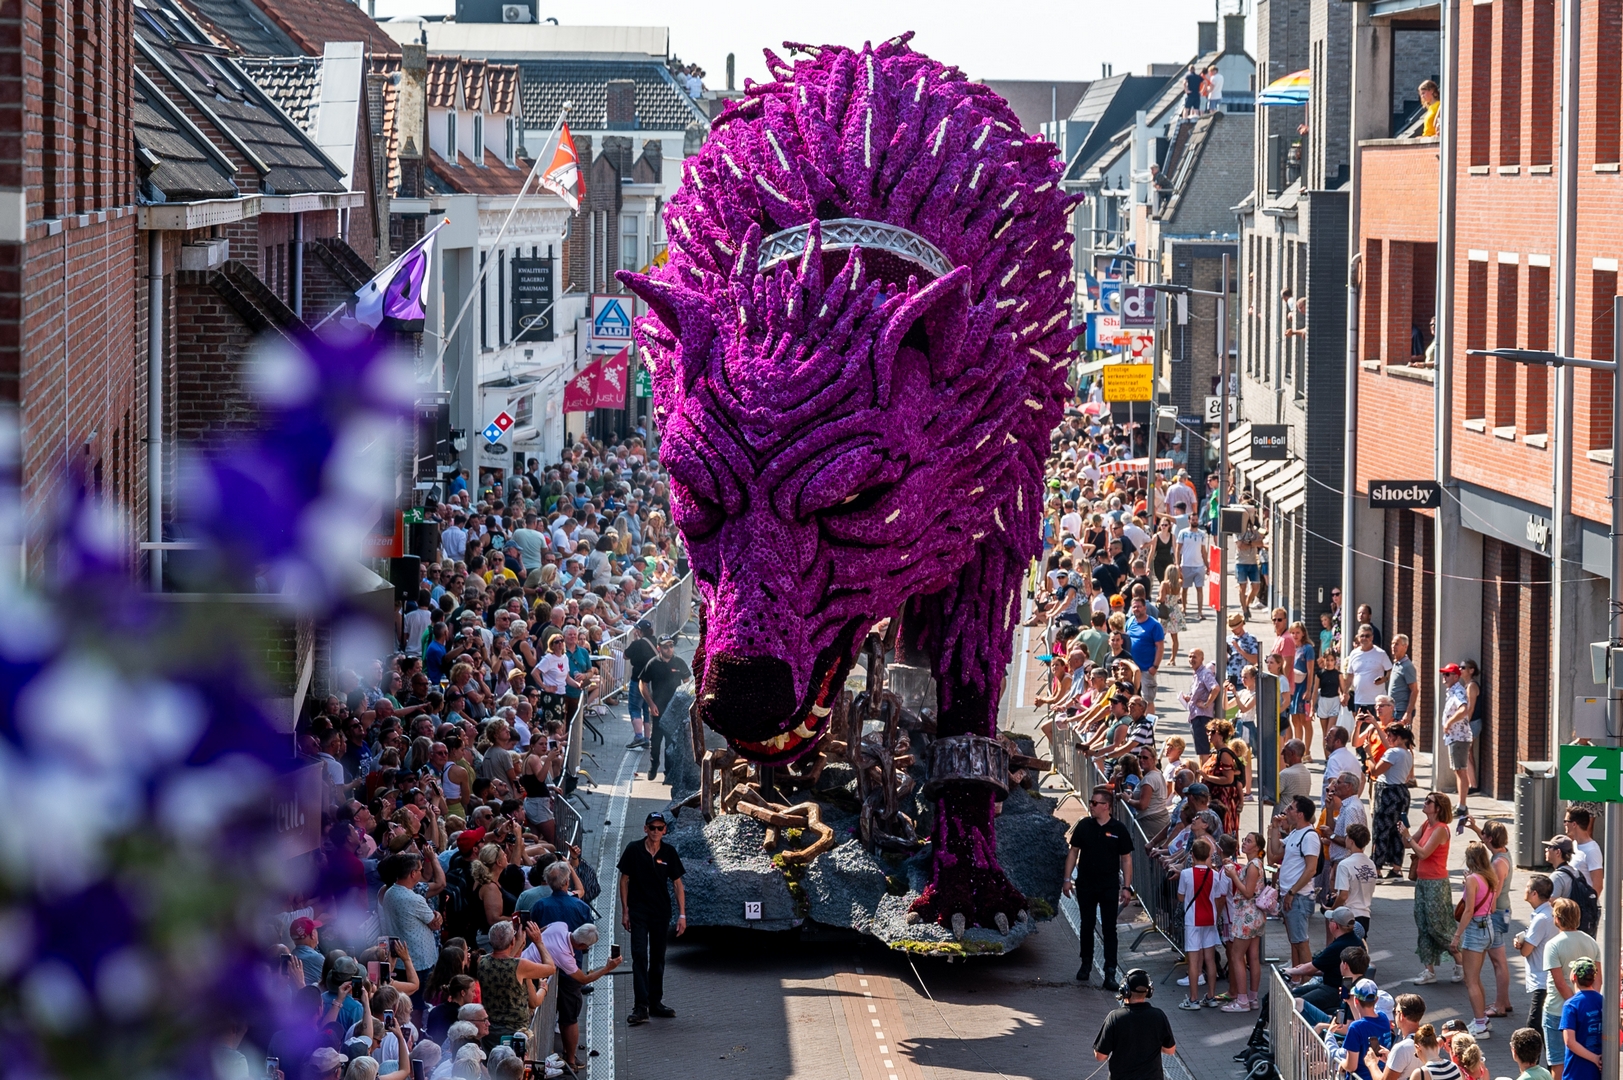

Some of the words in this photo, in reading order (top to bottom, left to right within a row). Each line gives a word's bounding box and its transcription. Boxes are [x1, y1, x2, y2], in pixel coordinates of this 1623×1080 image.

[599, 327, 627, 336] ALDI
[1372, 484, 1433, 505] shoeby
[747, 904, 760, 913] 12
